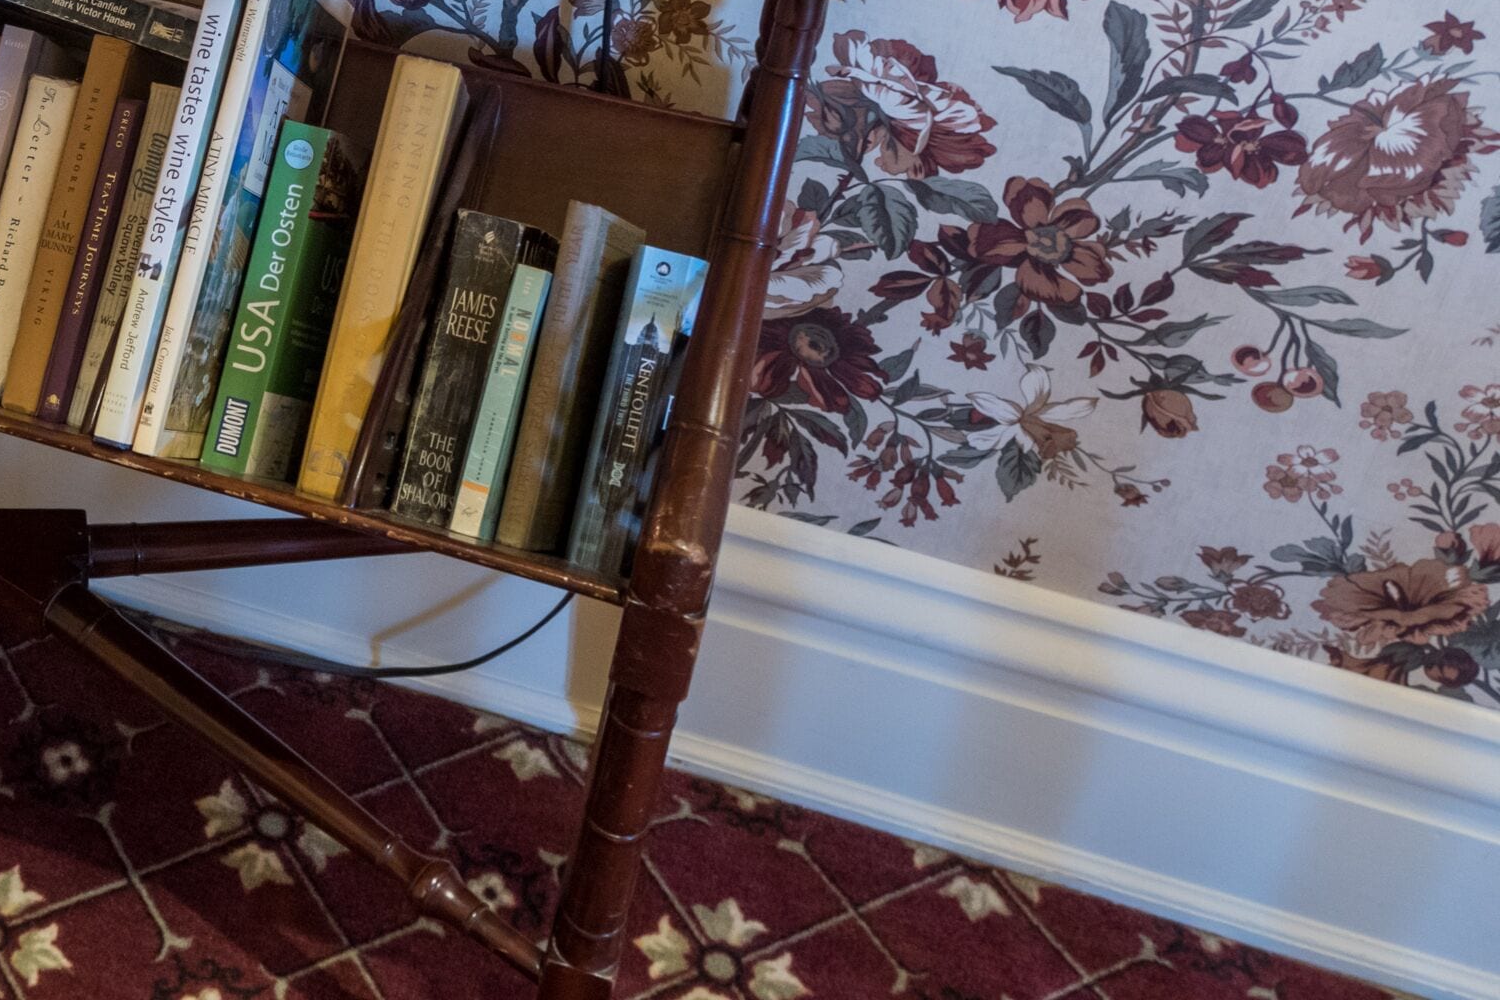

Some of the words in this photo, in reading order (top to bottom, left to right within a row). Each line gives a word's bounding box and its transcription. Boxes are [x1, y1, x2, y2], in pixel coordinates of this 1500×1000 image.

[75, 2, 102, 19] Victor
[103, 12, 137, 31] Hansen
[197, 14, 221, 60] wine
[236, 7, 257, 62] Wainwright
[40, 86, 57, 111] The
[83, 88, 101, 132] BRIAN
[180, 61, 211, 126] tastes
[22, 114, 51, 183] Letter
[115, 109, 131, 148] GRECO
[213, 131, 225, 142] A
[67, 142, 87, 193] MOORE
[166, 134, 191, 180] wine
[201, 145, 221, 182] TINY
[46, 229, 75, 244] MARY
[52, 219, 71, 231] AM
[120, 214, 138, 256] Squaw
[151, 187, 177, 244] styles
[185, 185, 212, 256] MIRACLE
[271, 184, 304, 247] Osten
[0, 217, 21, 272] Richard
[40, 239, 75, 255] DUNNE
[126, 215, 149, 283] Adventure
[72, 243, 98, 316] JOURNEYS
[106, 256, 123, 297] Valley
[260, 251, 286, 292] Der
[33, 268, 54, 327] VIKING
[130, 288, 149, 329] Andrew
[449, 287, 498, 319] JAMES
[162, 327, 175, 347] Jack
[232, 300, 281, 373] USA
[445, 312, 491, 345] REESE
[500, 308, 533, 377] NORMAL
[120, 332, 140, 371] Jefford
[150, 348, 171, 394] Crompton
[636, 357, 657, 389] KEN
[216, 398, 249, 456] DUMONT
[622, 387, 649, 452] FOLLETT
[418, 450, 454, 473] BOOK
[430, 432, 456, 454] THE
[422, 471, 443, 489] OF
